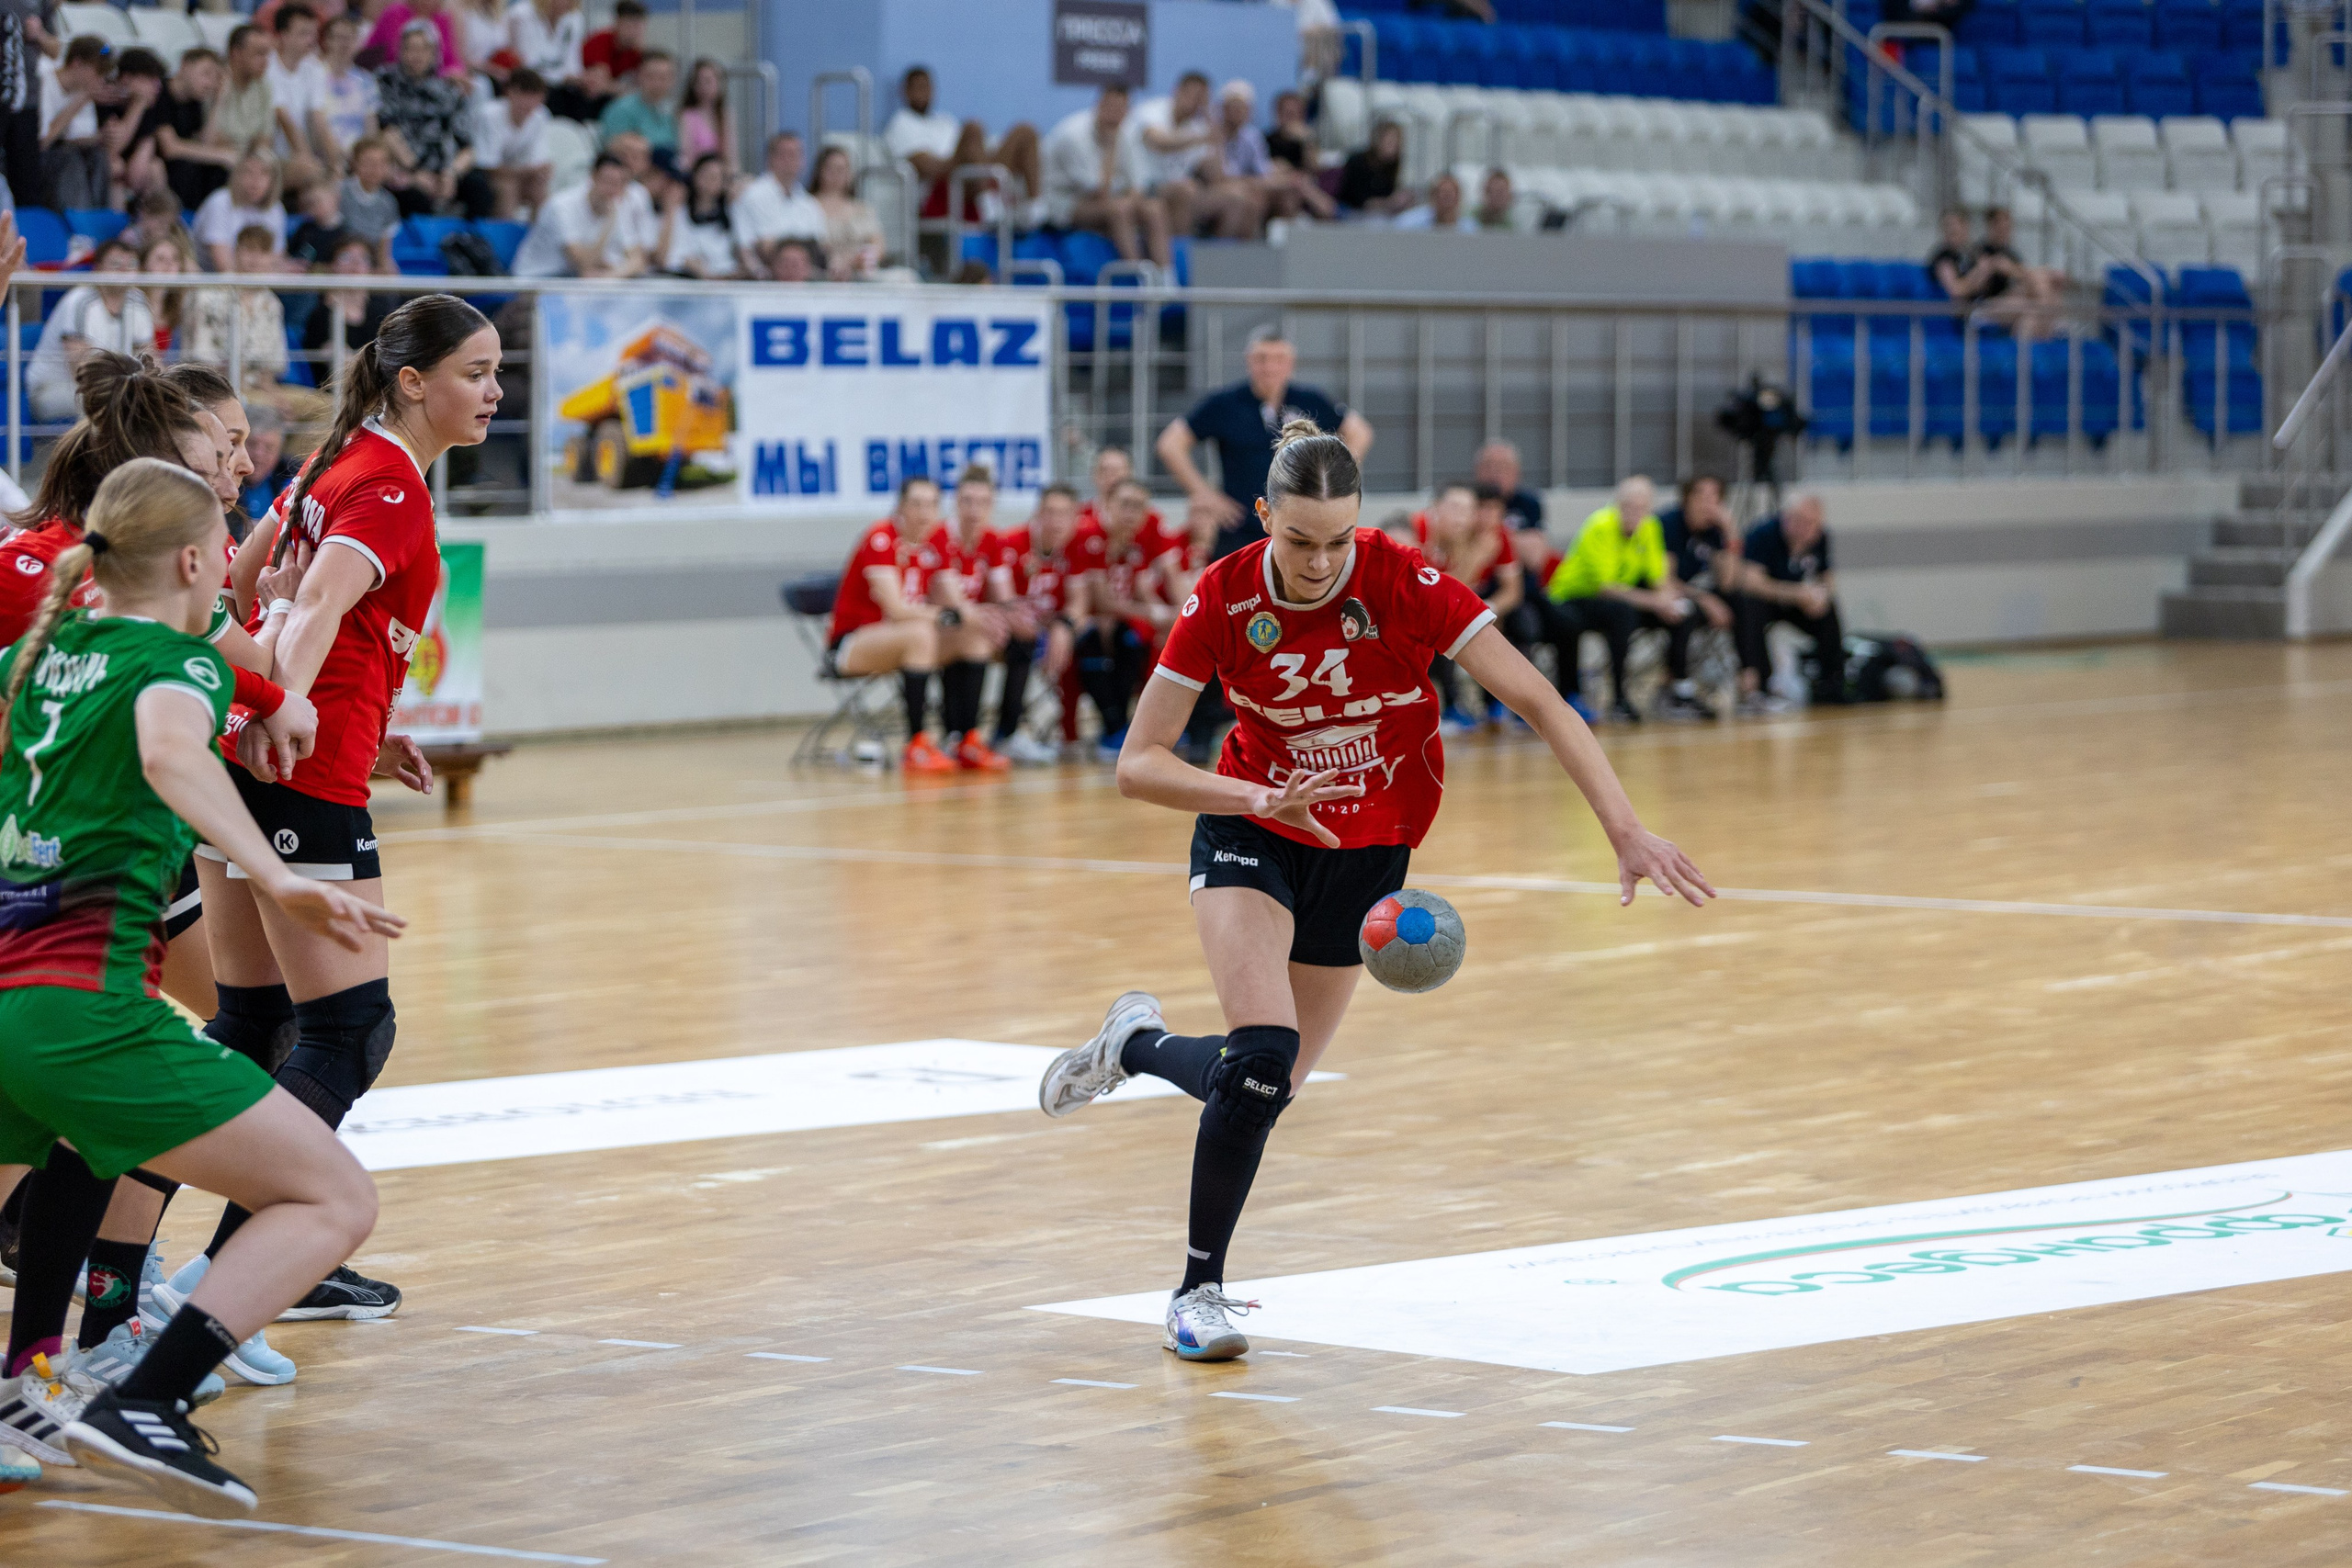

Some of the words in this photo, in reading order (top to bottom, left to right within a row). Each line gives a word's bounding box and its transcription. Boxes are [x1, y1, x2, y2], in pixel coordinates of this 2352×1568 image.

[752, 315, 1042, 367] BELAZ
[752, 439, 836, 495] МЫ
[1270, 649, 1352, 701] 34
[23, 700, 65, 807] 7
[356, 837, 379, 852] Kemp
[1213, 849, 1259, 867] Kempa
[1243, 1077, 1279, 1096] SELECT
